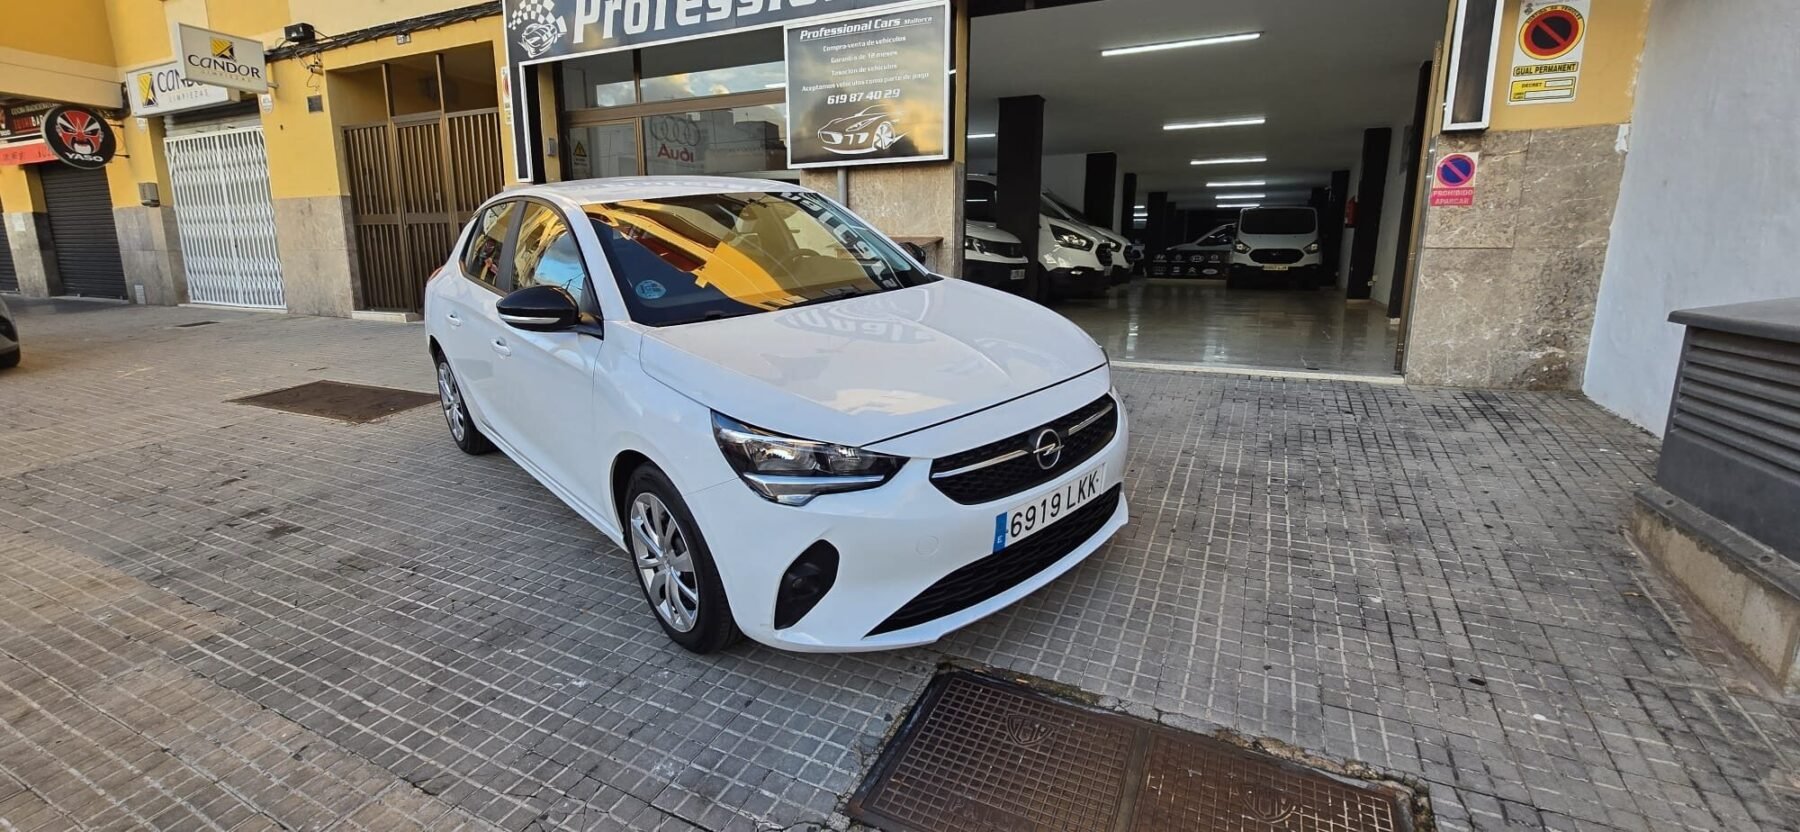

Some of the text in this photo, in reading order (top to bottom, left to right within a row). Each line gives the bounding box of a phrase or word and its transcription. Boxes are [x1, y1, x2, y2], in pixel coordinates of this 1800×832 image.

[800, 16, 933, 40] Professional Cars Mallorca
[1516, 63, 1576, 75] GUAL PERMANENT
[827, 88, 901, 105] 619 87 40 29
[64, 151, 104, 162] YASO
[657, 144, 694, 163] Audi
[1010, 470, 1098, 538] 6919 LKK
